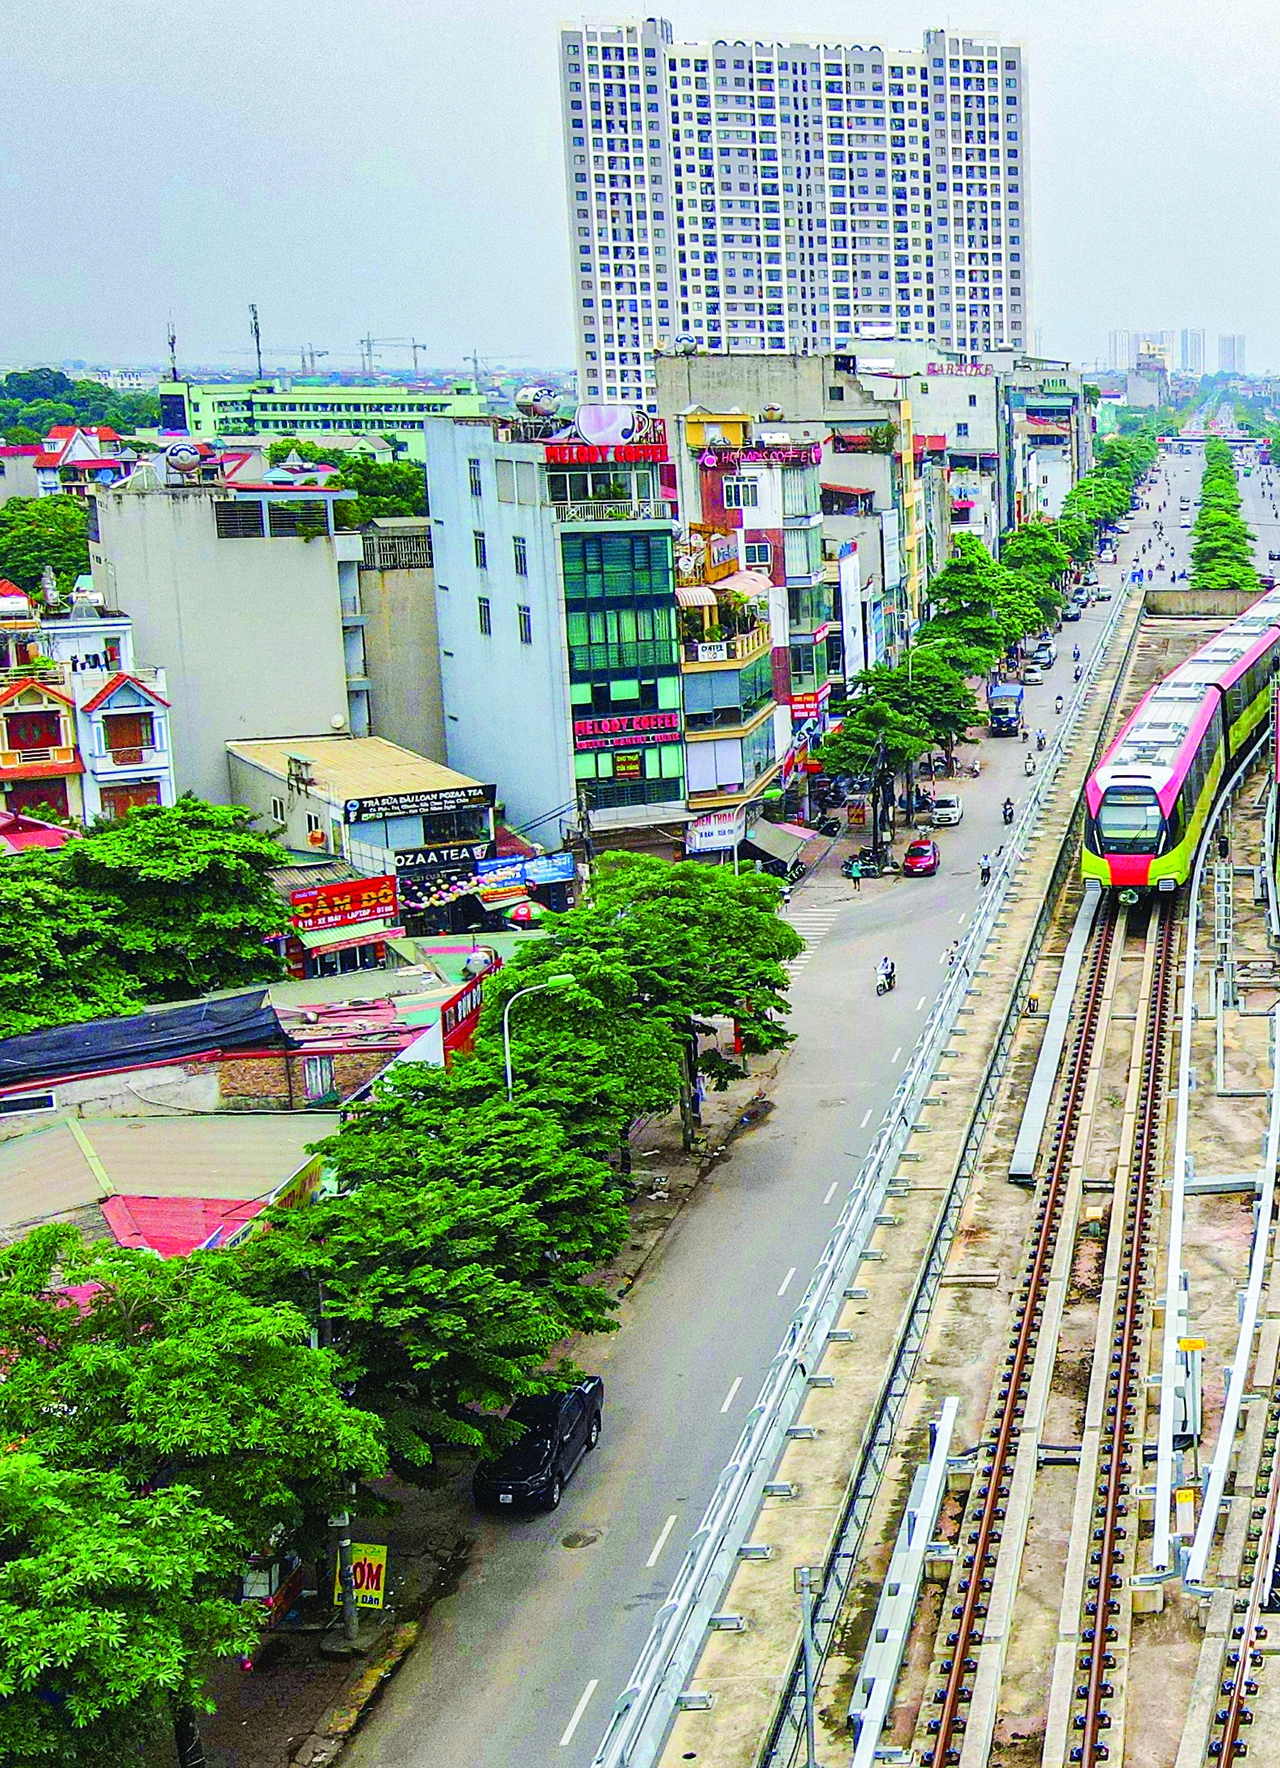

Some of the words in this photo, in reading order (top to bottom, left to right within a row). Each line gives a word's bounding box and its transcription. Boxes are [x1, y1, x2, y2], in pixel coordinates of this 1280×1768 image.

[927, 362, 993, 376] KARAOKE
[545, 445, 609, 463] MELODY
[614, 444, 669, 462] COFFEE
[574, 717, 629, 736] MELODY
[632, 713, 679, 730] COFFEE
[362, 800, 380, 808] TRÀ
[381, 796, 398, 805] SỮA
[395, 851, 438, 867] OZAA
[440, 848, 470, 861] TEA
[297, 892, 352, 918] CẦM
[361, 881, 393, 908] ĐỒ
[347, 1556, 383, 1591] ƠM
[361, 1594, 380, 1606] Dân
